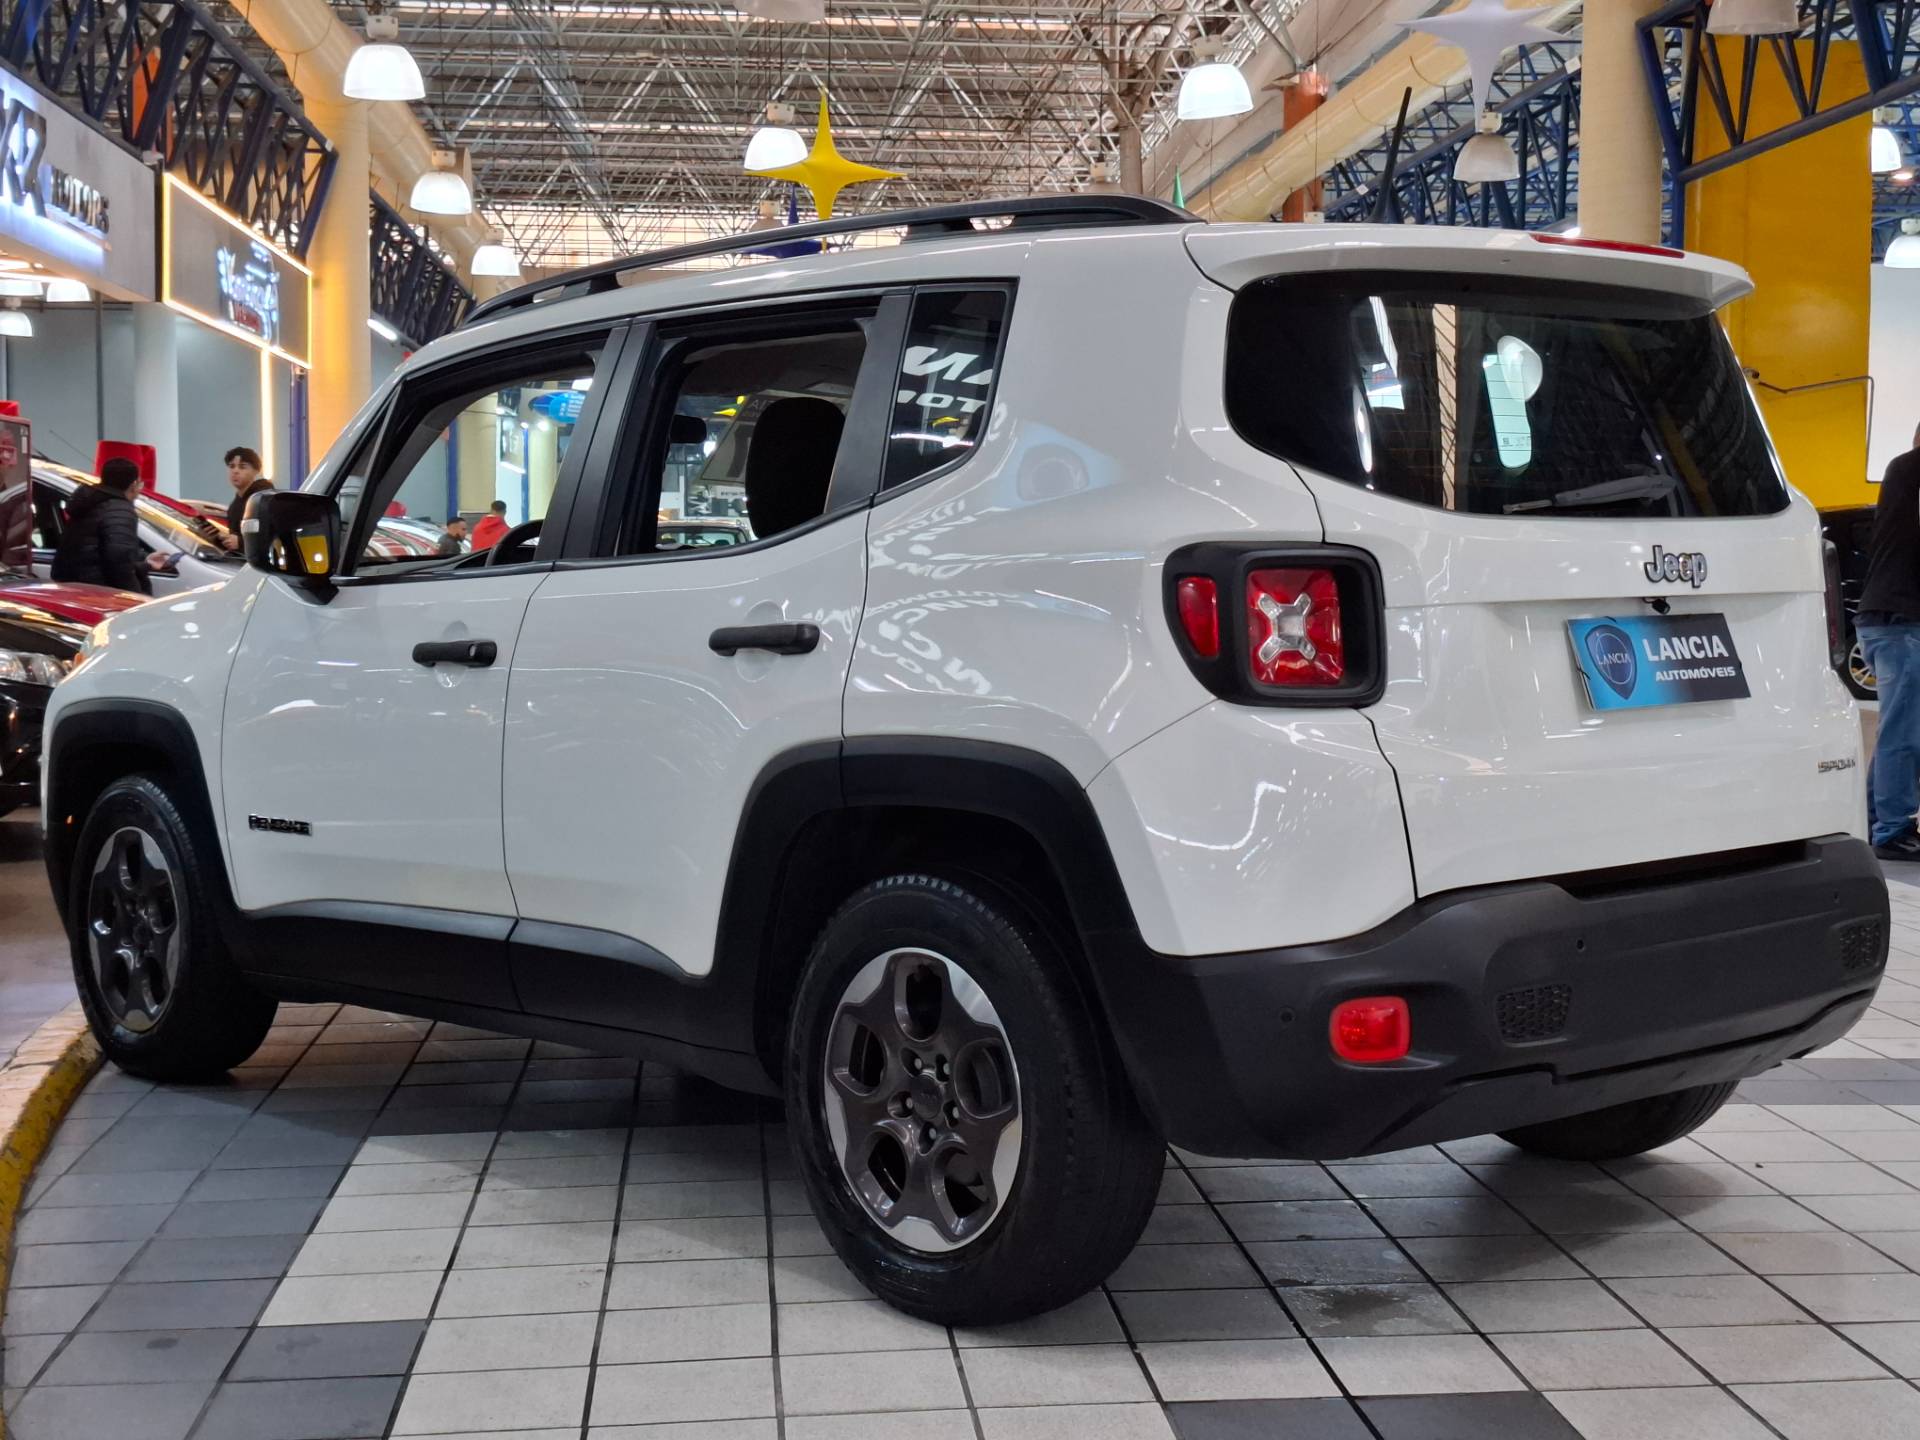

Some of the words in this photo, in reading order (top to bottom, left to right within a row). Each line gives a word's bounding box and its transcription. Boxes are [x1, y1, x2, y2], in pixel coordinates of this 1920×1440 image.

[51, 165, 110, 234] MOTORS
[1643, 544, 1708, 589] Jeep
[1596, 651, 1632, 665] LANCIA
[1641, 635, 1729, 662] LANCIA
[1655, 665, 1736, 682] AUTOMÓVEIS
